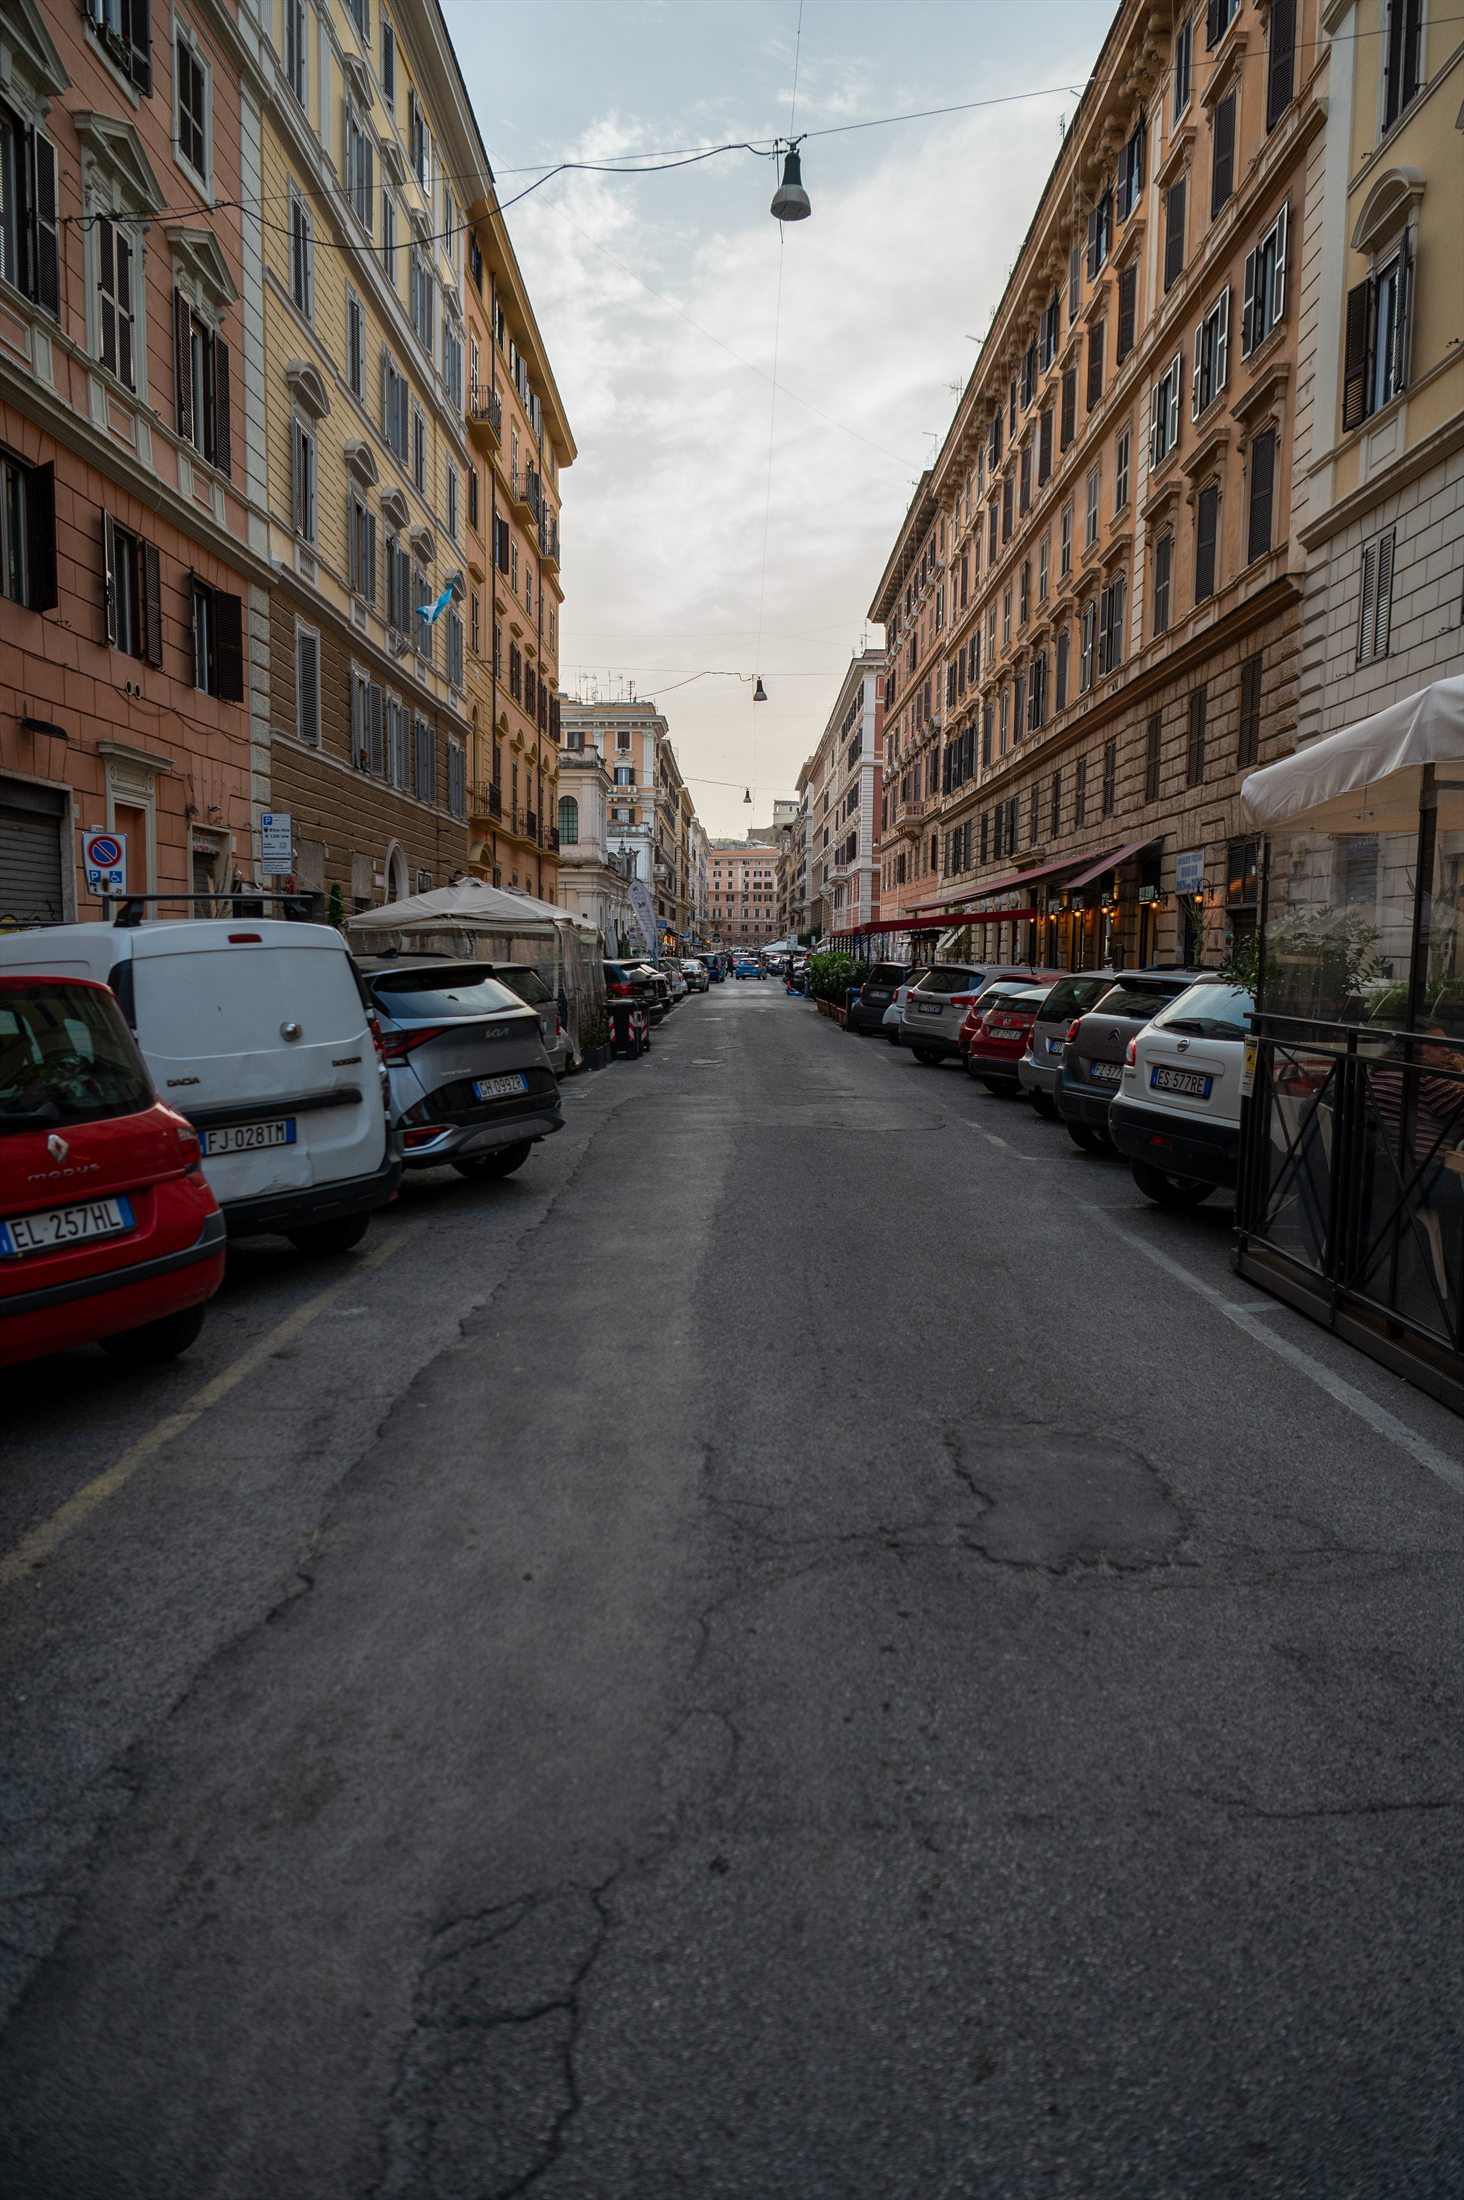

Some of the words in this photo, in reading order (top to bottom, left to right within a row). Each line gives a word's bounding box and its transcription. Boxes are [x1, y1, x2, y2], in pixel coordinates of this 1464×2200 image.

[91, 872, 99, 880] P
[485, 1027, 510, 1039] KIA
[167, 1077, 200, 1087] DACIA
[1157, 1070, 1169, 1086] ES
[1173, 1073, 1204, 1093] 577RE
[208, 1130, 227, 1152] FJ
[235, 1122, 285, 1147] 028TM
[10, 1220, 43, 1249] EL
[49, 1203, 121, 1240] 257HL
